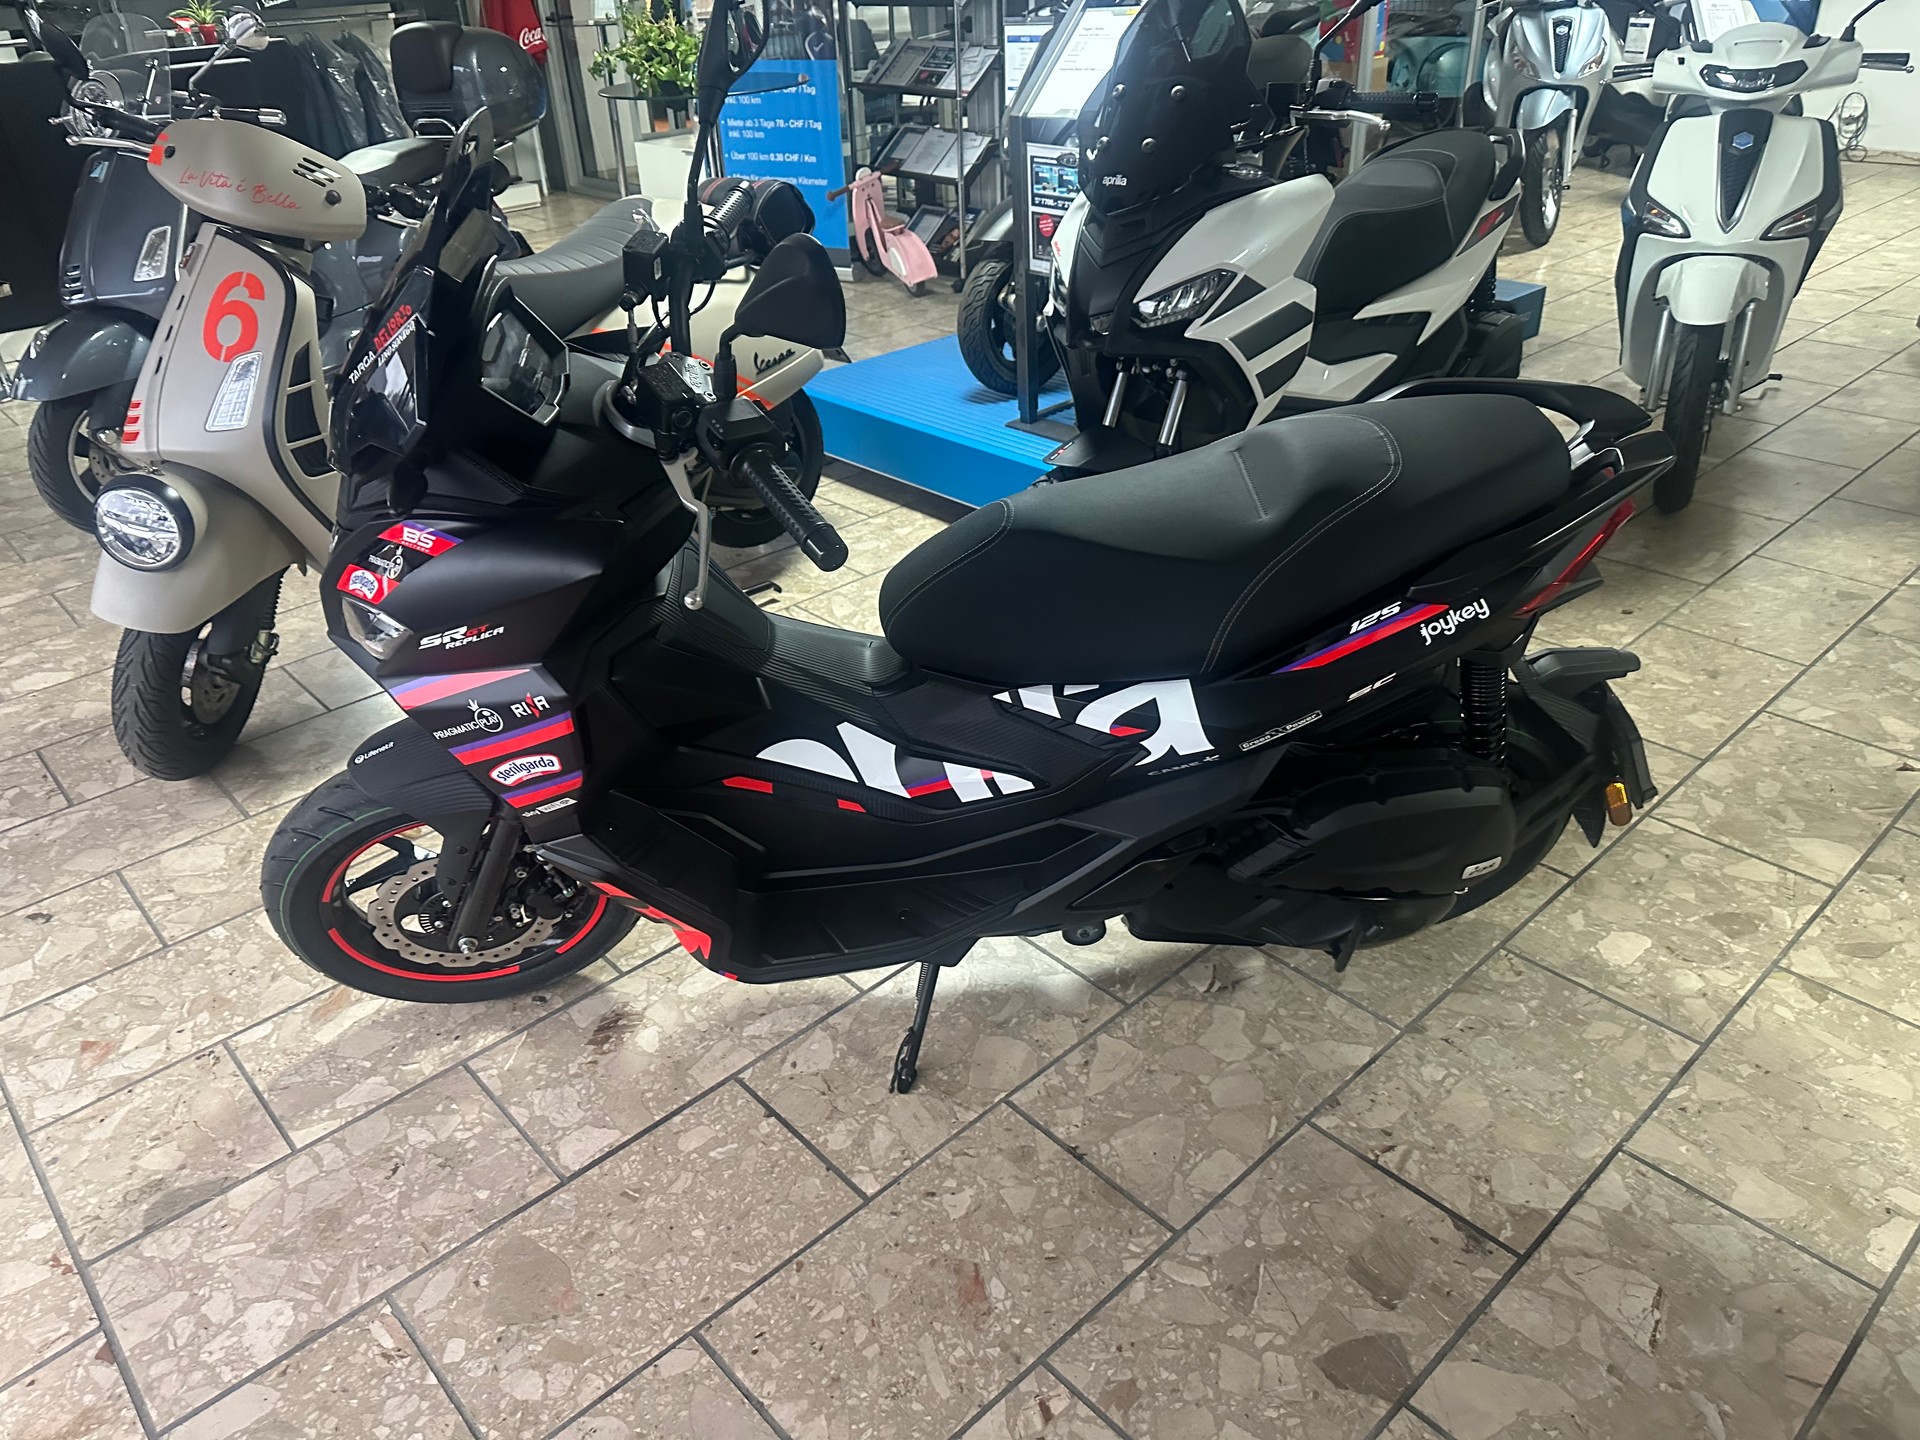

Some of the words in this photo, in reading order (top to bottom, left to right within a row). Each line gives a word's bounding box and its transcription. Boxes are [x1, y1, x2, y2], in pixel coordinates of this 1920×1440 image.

[803, 84, 816, 95] Tag
[760, 119, 775, 129] Tage
[789, 119, 804, 128] CHF
[809, 120, 822, 130] Tag
[784, 153, 799, 161] CHF
[179, 168, 198, 184] La
[200, 170, 232, 188] Vita
[251, 183, 301, 209] Bella
[1102, 175, 1127, 187] aprilia
[203, 271, 265, 363] 6
[753, 350, 796, 375] Vespa
[402, 527, 436, 548] BS
[1349, 601, 1402, 634] 125
[1419, 599, 1490, 645] joykey
[418, 625, 468, 650] SR
[445, 626, 504, 650] REPLICA
[433, 721, 480, 740] PRAGMATIC
[480, 714, 499, 728] PLAY
[1285, 712, 1318, 732] Power
[496, 756, 555, 781] sterilgarda
